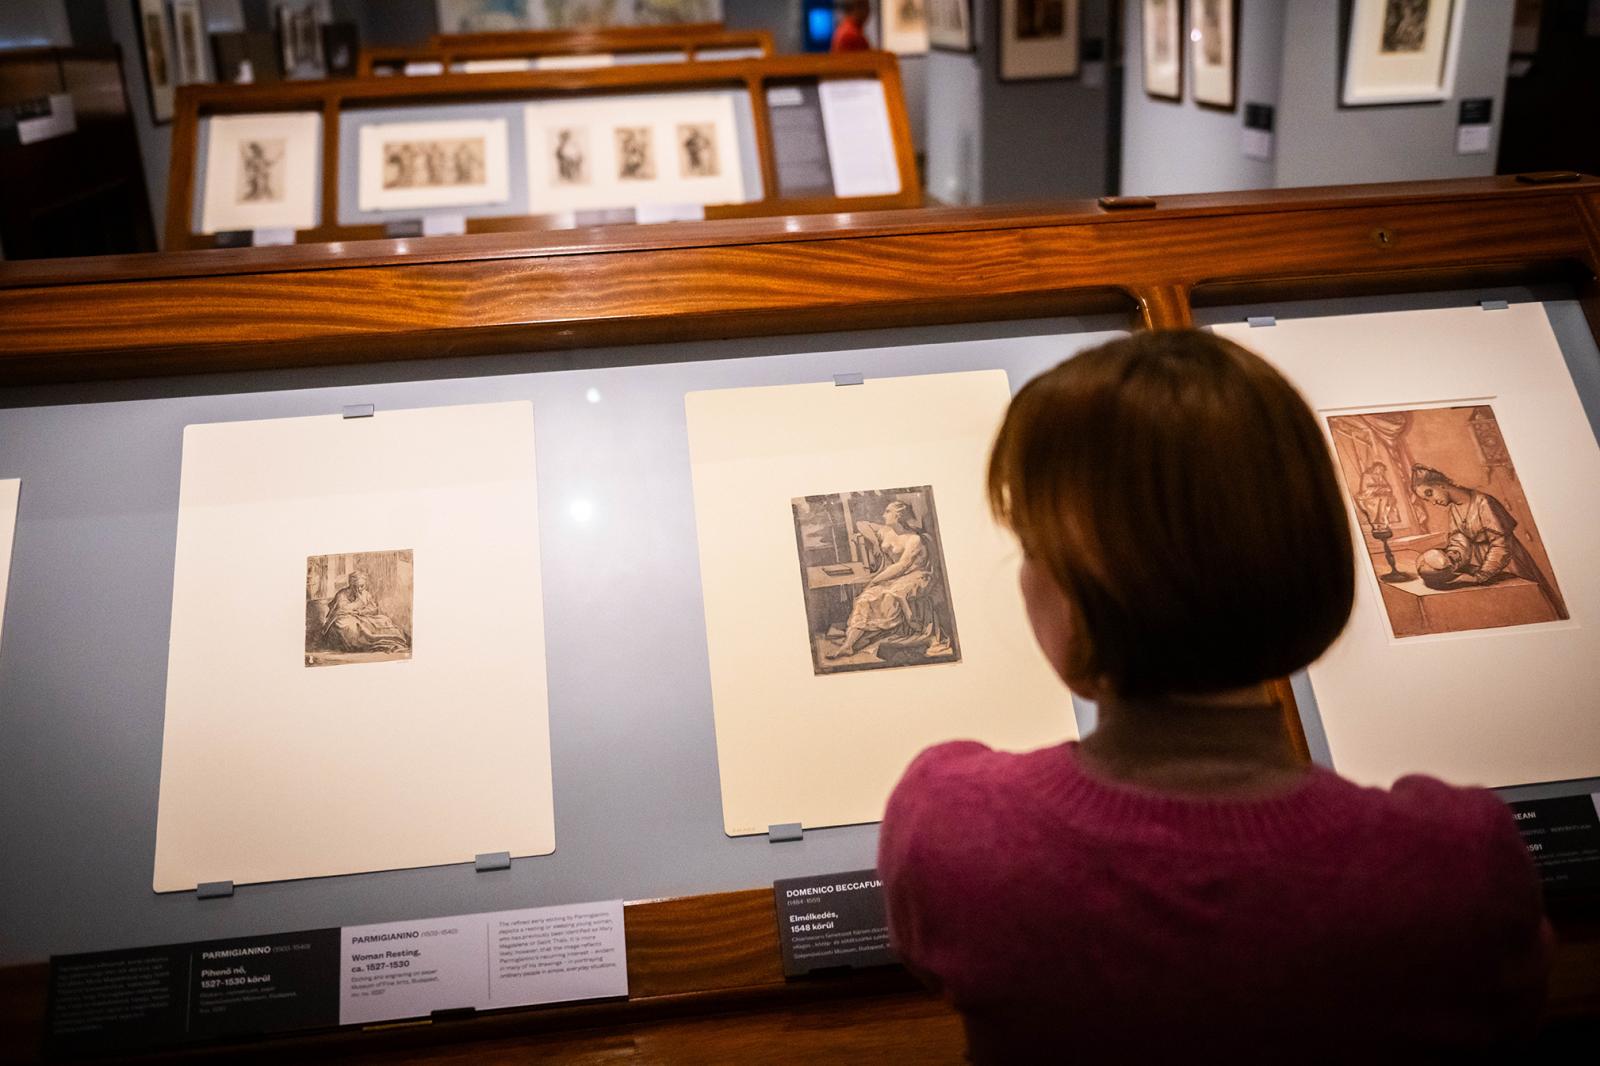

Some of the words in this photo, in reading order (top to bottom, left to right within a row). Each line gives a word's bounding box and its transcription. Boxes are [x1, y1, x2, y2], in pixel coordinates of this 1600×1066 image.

[786, 885, 833, 897] DOMENICO
[835, 879, 883, 891] BECCAFUM
[789, 911, 838, 922] Elmélkedés,
[790, 924, 810, 932] 1548
[812, 921, 833, 930] körül
[351, 931, 418, 944] PARMIGIANINO
[202, 945, 272, 960] PARMIGIANINO
[351, 952, 383, 961] Woman
[386, 948, 421, 959] Resting,
[201, 967, 232, 978] Pihenő
[247, 974, 271, 984] körül
